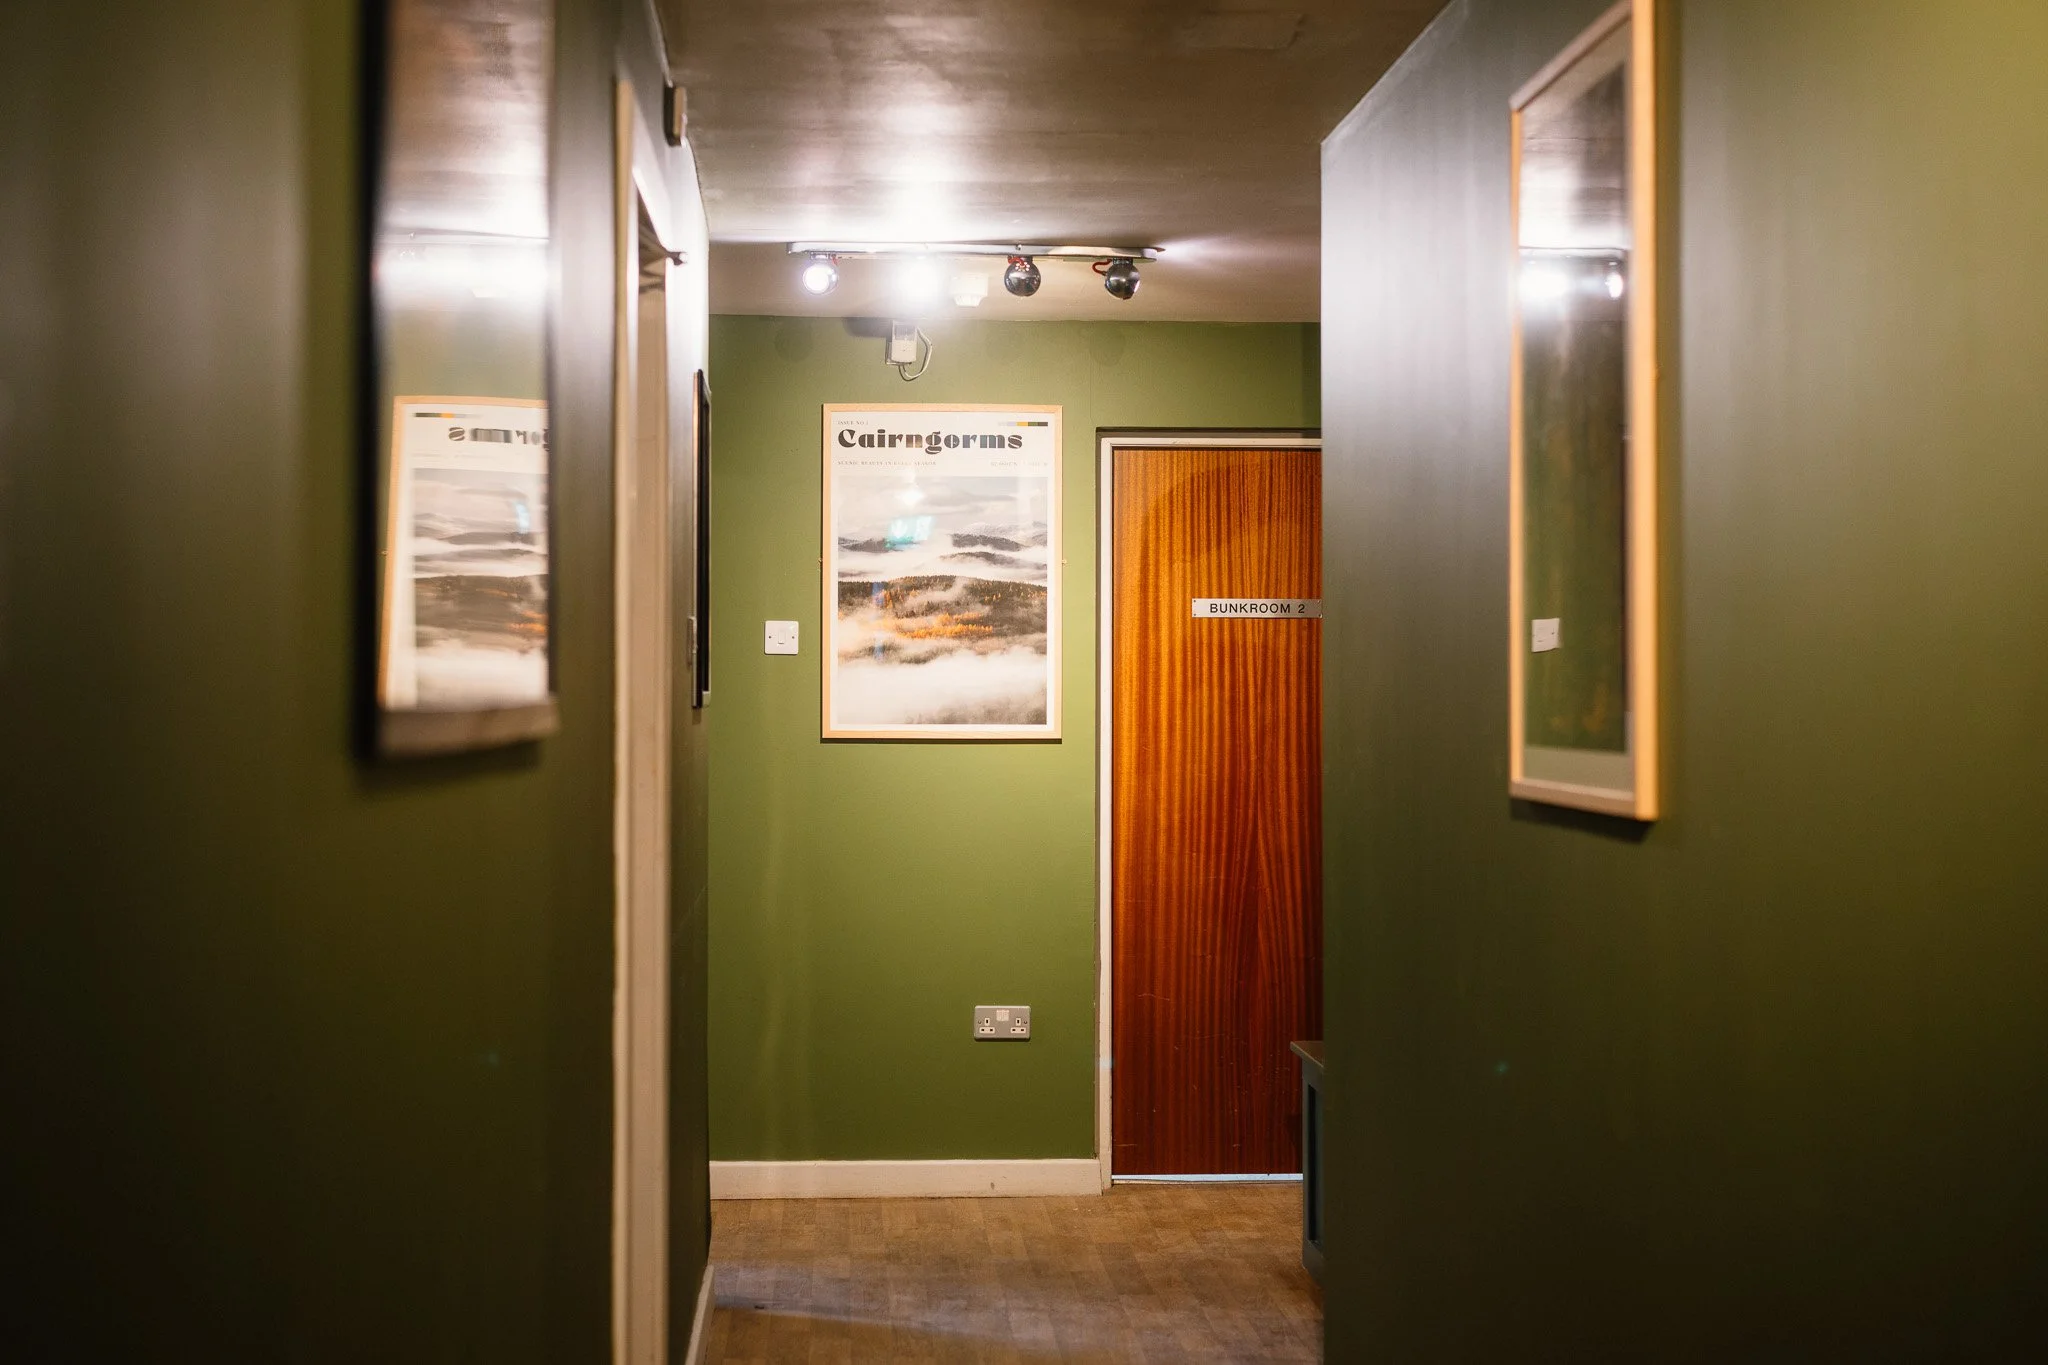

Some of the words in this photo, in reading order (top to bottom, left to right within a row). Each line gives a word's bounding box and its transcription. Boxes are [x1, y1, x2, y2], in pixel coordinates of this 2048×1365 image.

[838, 429, 1022, 455] Cairngorms
[1210, 603, 1290, 613] BUNKROOM
[1298, 603, 1305, 613] 2
